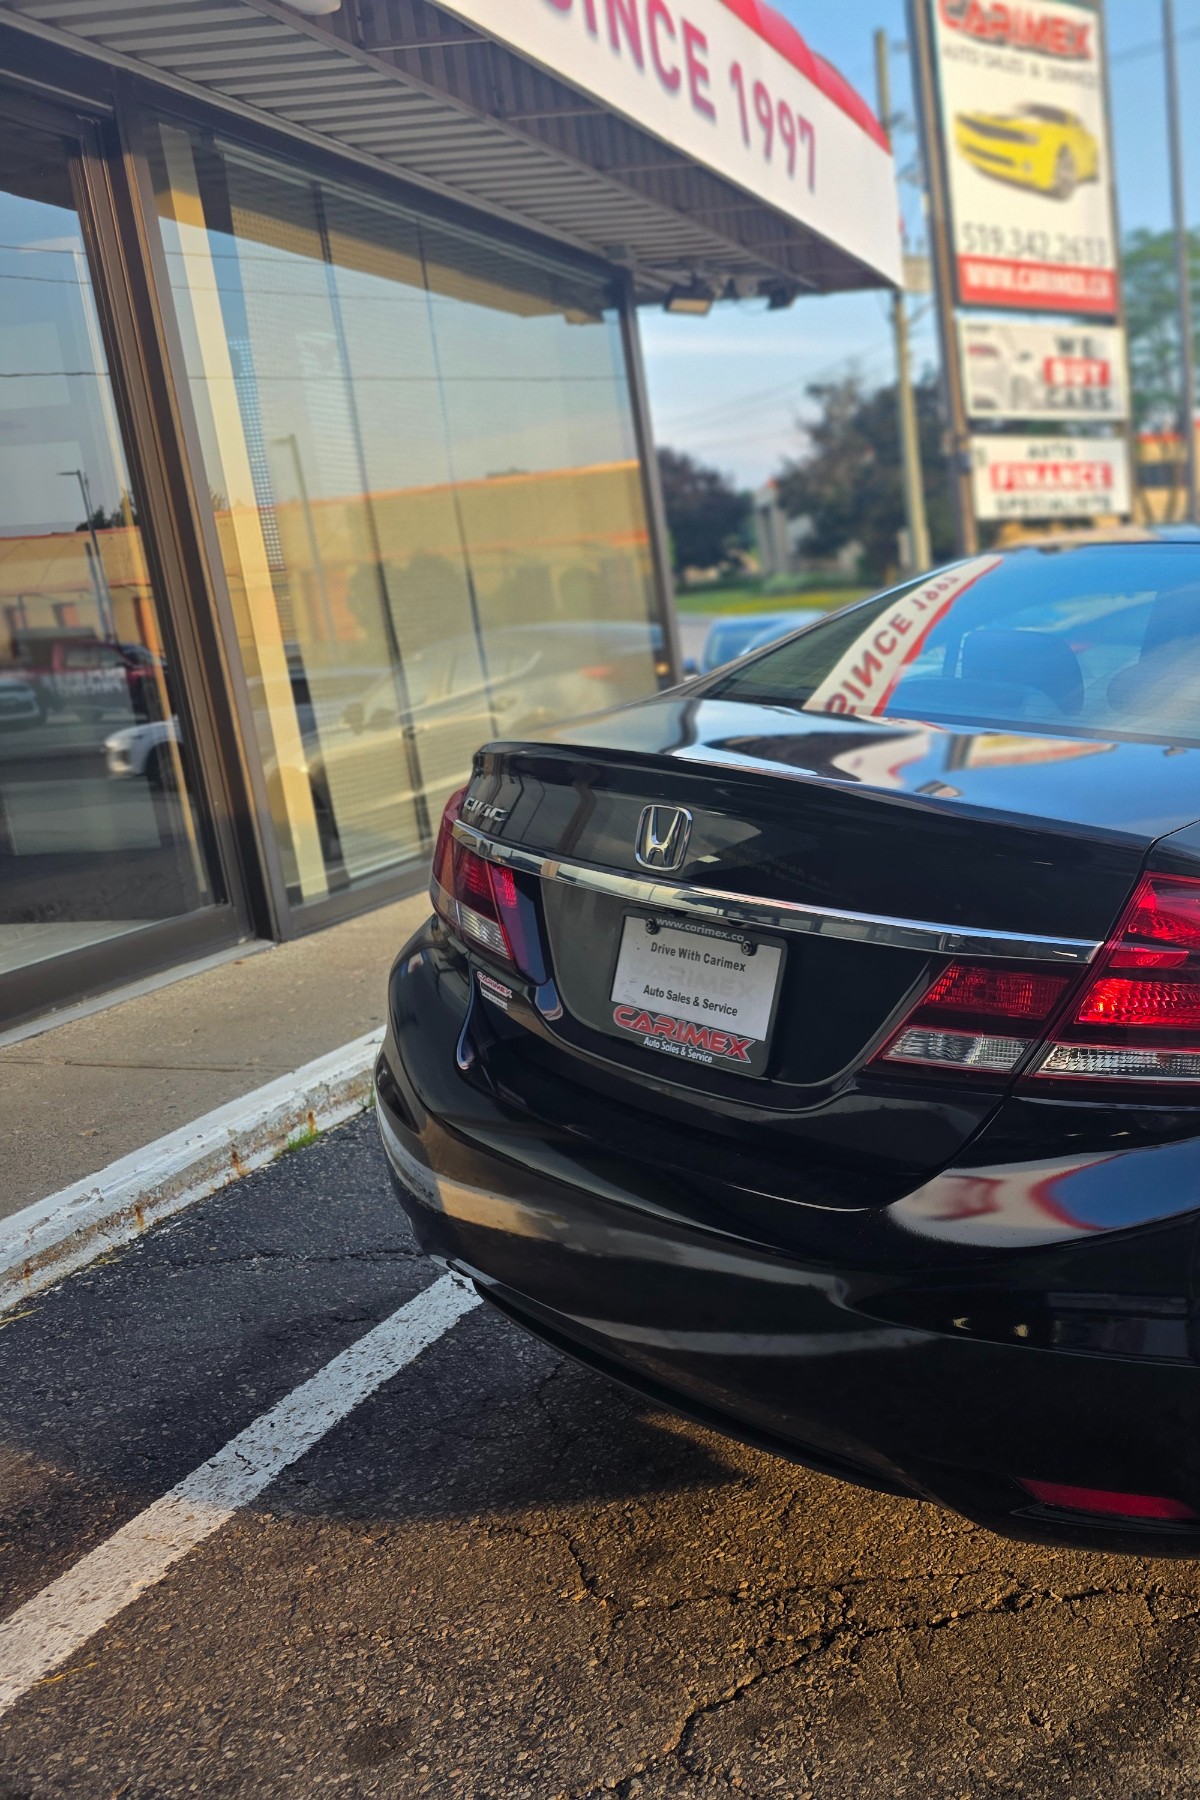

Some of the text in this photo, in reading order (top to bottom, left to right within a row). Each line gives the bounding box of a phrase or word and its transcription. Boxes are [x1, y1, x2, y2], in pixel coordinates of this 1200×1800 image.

[937, 0, 1092, 59] CARIMEX
[547, 0, 815, 192] NCE 1997
[1055, 335, 1092, 356] WE
[1050, 360, 1104, 386] BUY
[1046, 388, 1113, 410] CARS
[1028, 444, 1075, 459] AUTO
[997, 463, 1105, 489] FINANCE
[464, 797, 508, 822] CIVIC
[656, 918, 744, 942] www.carimex.ca
[651, 942, 746, 973] Drive With Carimex
[477, 971, 512, 999] CARIMEX
[643, 984, 738, 1016] Auto Sales & Service
[613, 1005, 755, 1063] CARIMEX
[643, 1037, 713, 1064] Auto Sales & Service
